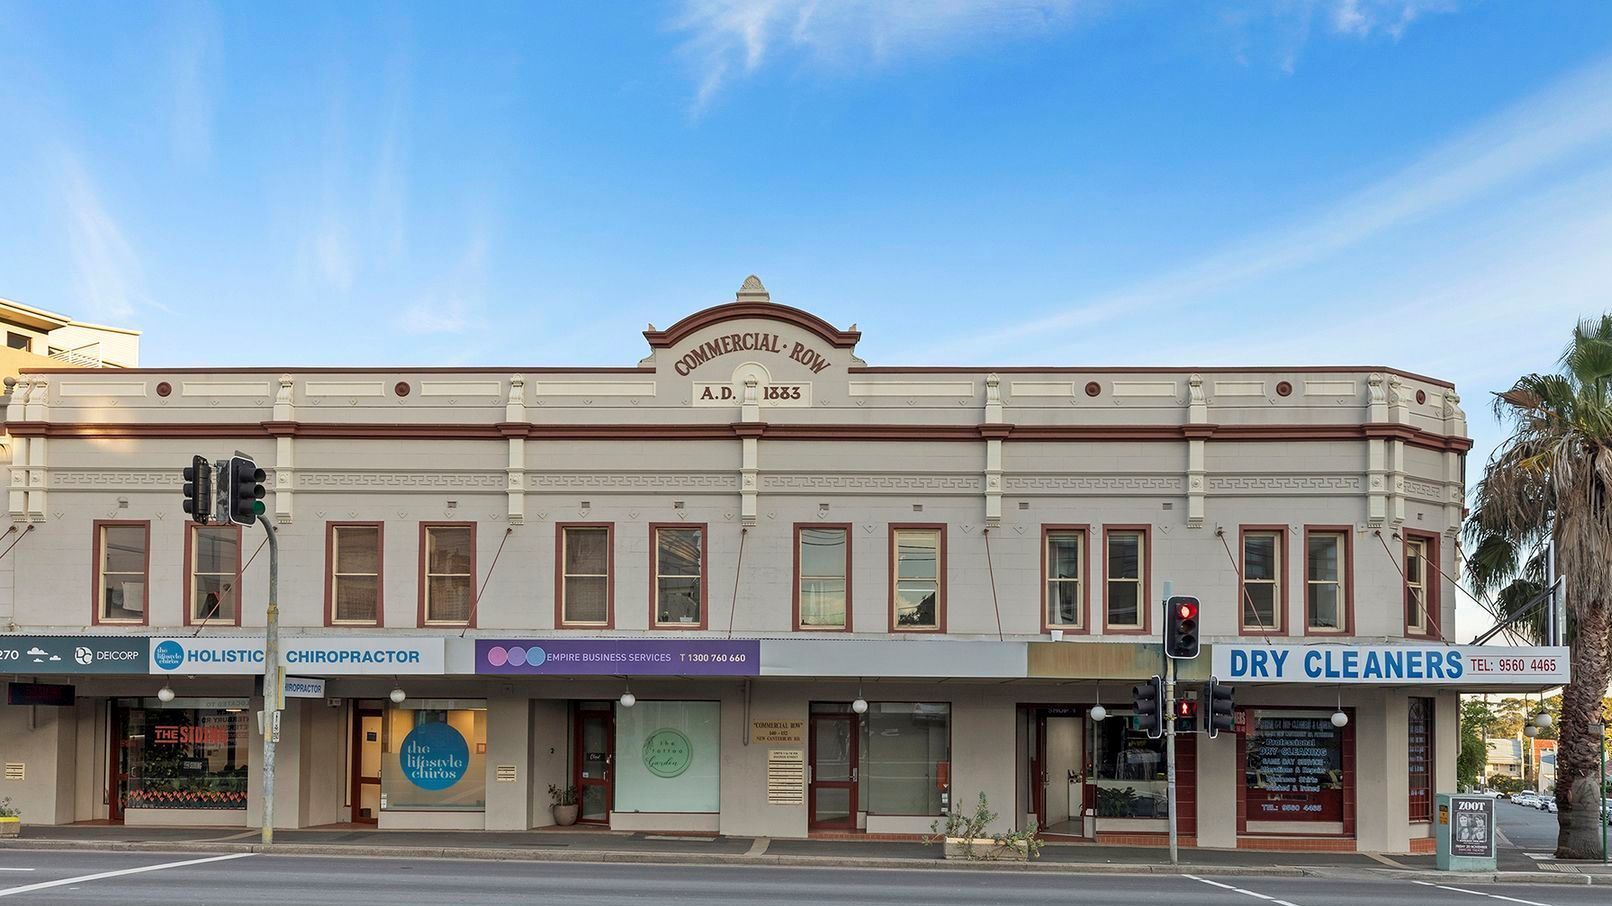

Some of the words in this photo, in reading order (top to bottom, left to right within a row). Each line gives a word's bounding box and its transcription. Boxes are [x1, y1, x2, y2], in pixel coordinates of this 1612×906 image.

[674, 332, 781, 377] COMMERCIAL
[788, 341, 832, 375] ROW
[700, 386, 737, 400] A.D.
[763, 386, 801, 400] 1883
[96, 651, 139, 660] DEICORP
[188, 649, 265, 663] HOLISTIC
[286, 650, 420, 663] CHIROPRACTOR
[547, 653, 581, 662] EMPIRE
[582, 653, 627, 662] BUSINESS
[628, 653, 671, 662] SERVICES
[680, 654, 686, 662] T
[688, 654, 709, 662] 1300
[711, 654, 727, 663] 760
[729, 654, 746, 663] 660
[1230, 649, 1289, 678] DRY
[1304, 649, 1463, 680] CLEANERS
[1471, 658, 1493, 672] TEL:
[1499, 658, 1524, 672] 9560
[1530, 659, 1556, 672] 4465
[154, 729, 179, 739] THE
[407, 740, 430, 753] the
[1259, 747, 1279, 756] DRY
[1280, 747, 1328, 757] CLEANING
[407, 754, 463, 769] lifestyle
[1282, 758, 1295, 766] DAY
[411, 766, 457, 779] chiros
[1458, 801, 1486, 811] ZOOT
